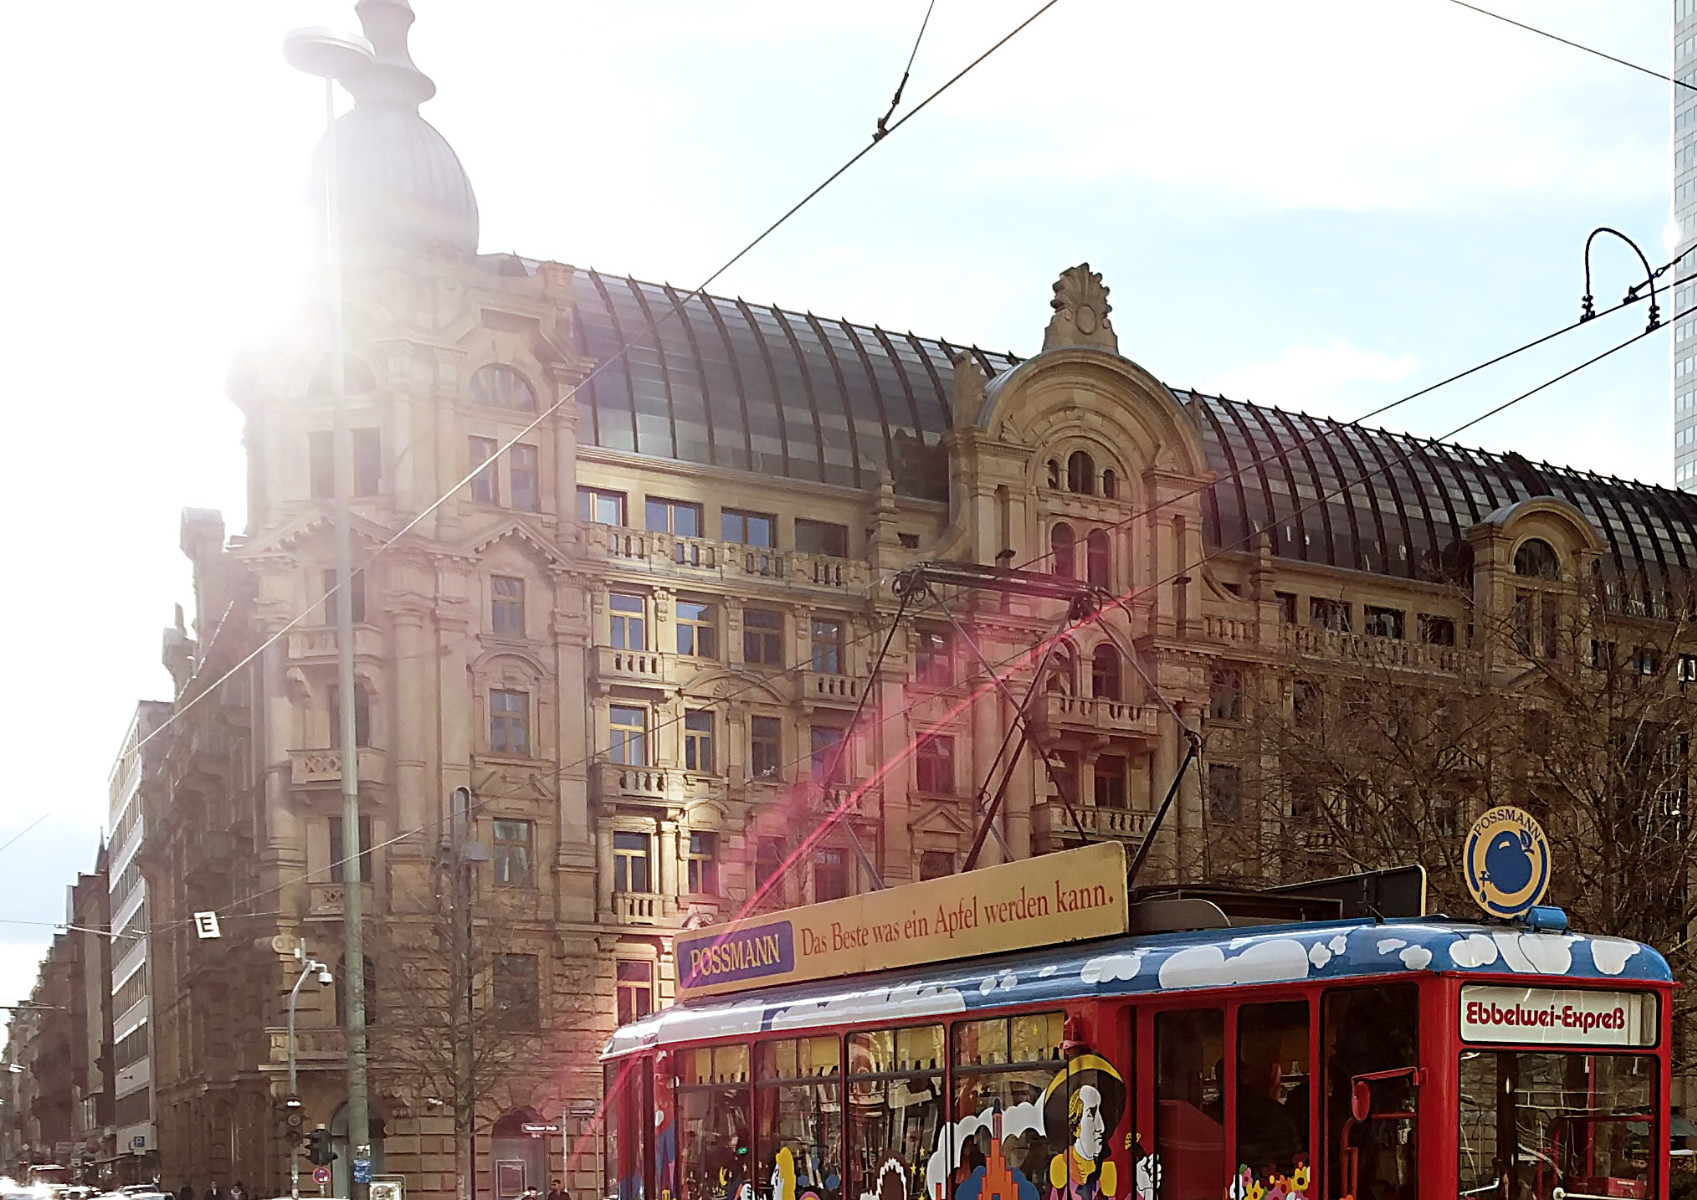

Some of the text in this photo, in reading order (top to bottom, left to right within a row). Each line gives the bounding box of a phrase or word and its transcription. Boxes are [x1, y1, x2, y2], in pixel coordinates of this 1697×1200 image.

[1472, 808, 1542, 843] POSSMANN
[199, 916, 215, 933] E
[801, 879, 1114, 956] Das Beste was ein Apfel werden kann.
[690, 934, 781, 977] POSSMANN
[1466, 1001, 1625, 1034] Ebbelwei-Expreß
